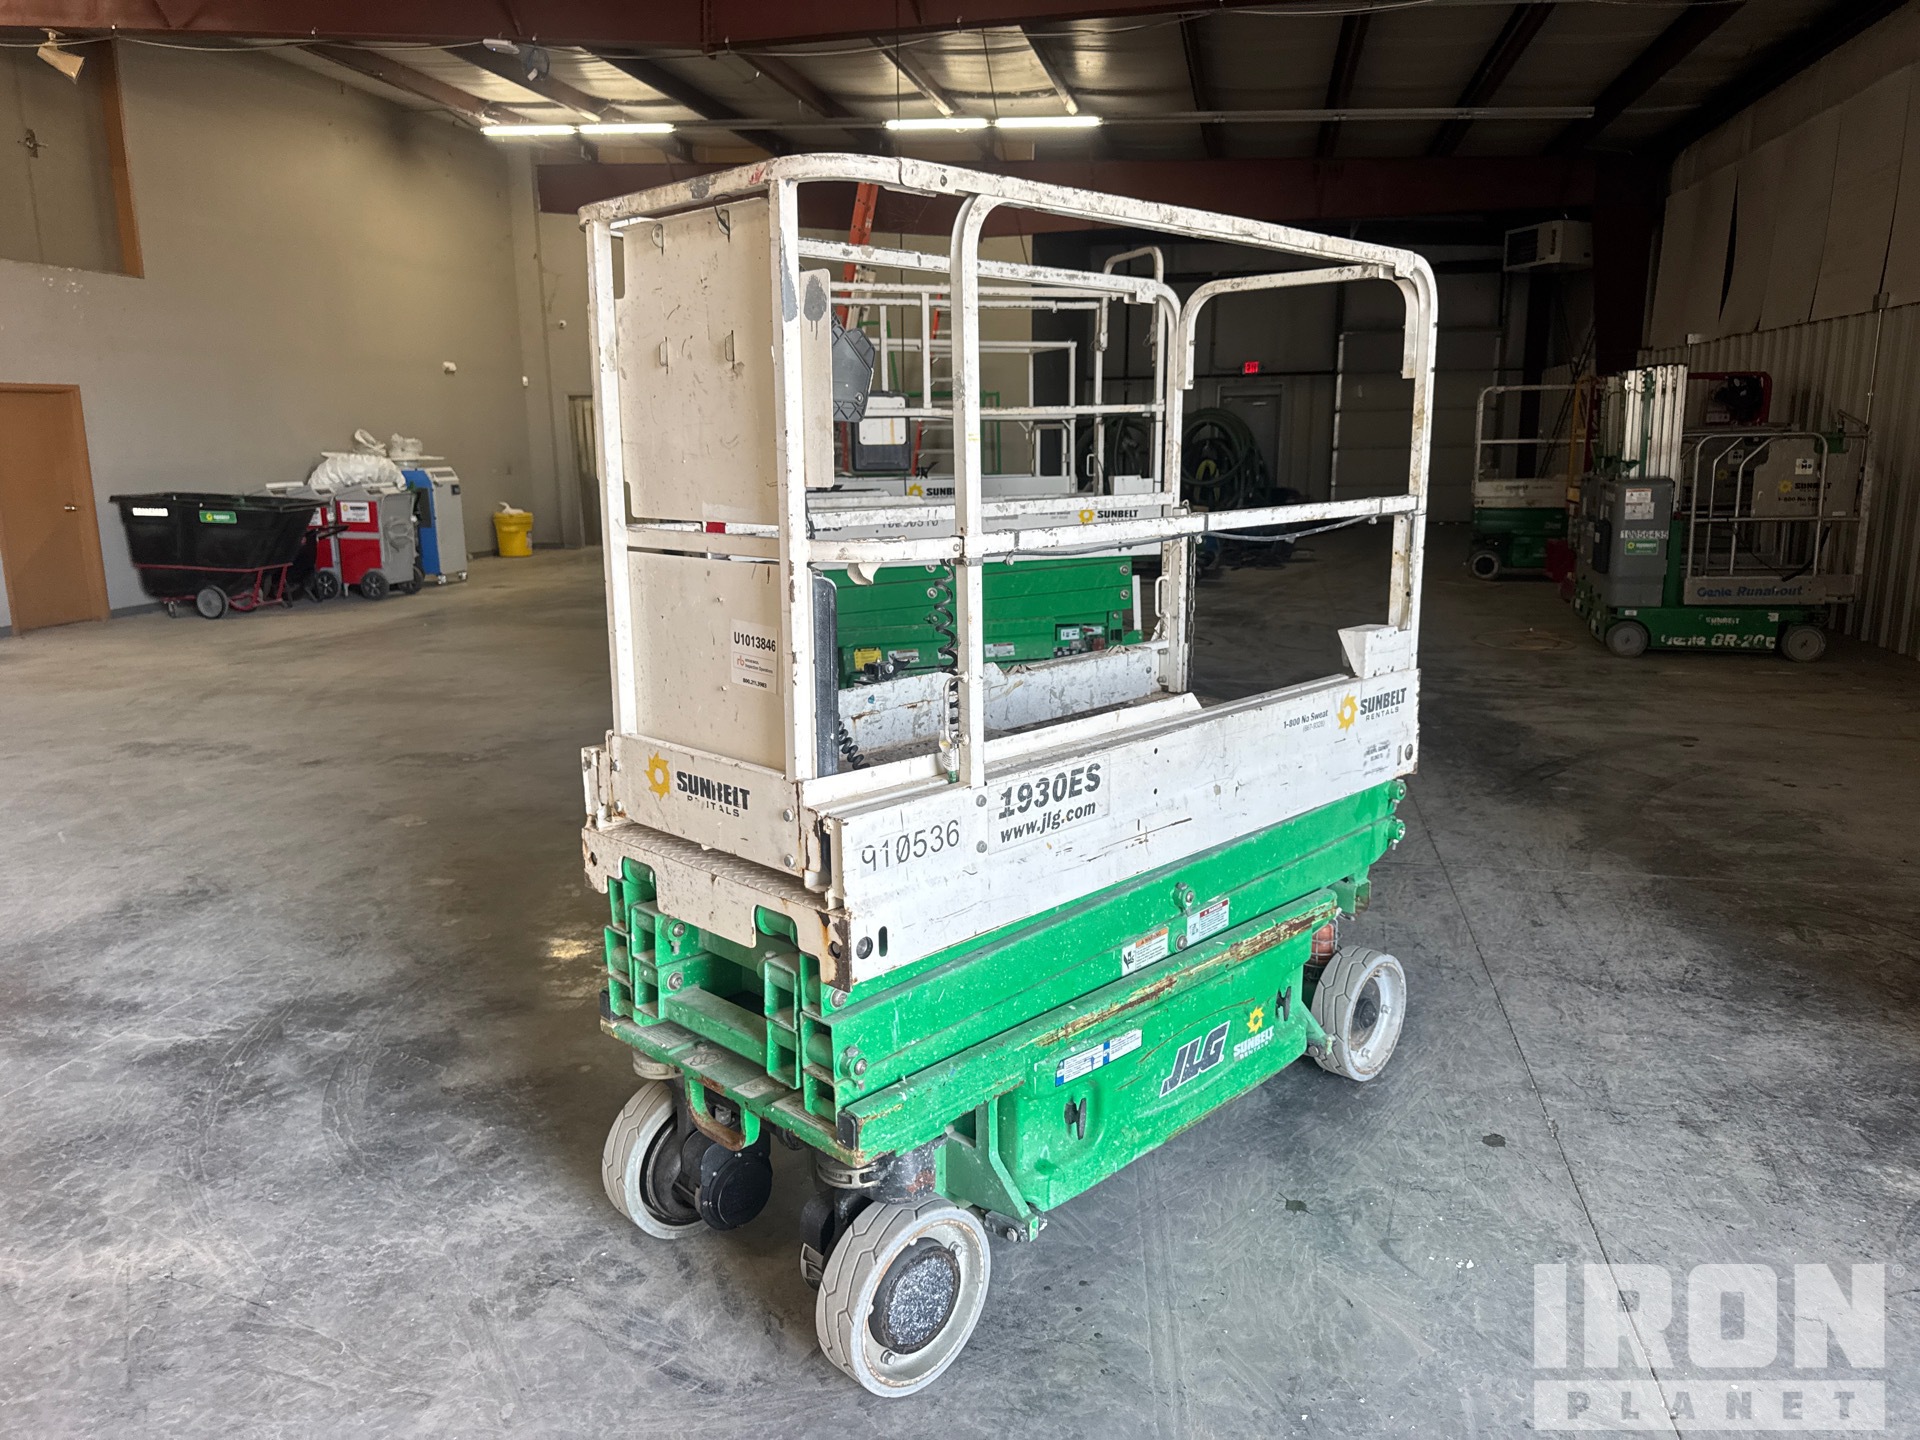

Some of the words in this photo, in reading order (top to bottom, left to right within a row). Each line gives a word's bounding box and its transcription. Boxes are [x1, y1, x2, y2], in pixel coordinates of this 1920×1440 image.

[926, 487, 956, 497] SUNB
[1097, 509, 1139, 519] SUNBELT
[1697, 587, 1732, 598] Genie
[1737, 585, 1803, 597] Runabout
[733, 631, 776, 653] U1013846
[1360, 687, 1408, 716] SUNBELT
[1366, 706, 1400, 721] RENTALS
[1283, 715, 1300, 729] 1-800
[1301, 714, 1310, 724] No
[1311, 709, 1329, 721] Sweat
[998, 762, 1102, 820] 1930ES
[1000, 800, 1097, 844] www.jlg.com
[861, 819, 961, 872] 910536
[1233, 1025, 1275, 1058] SUNBELT
[1159, 1020, 1231, 1099] JLG
